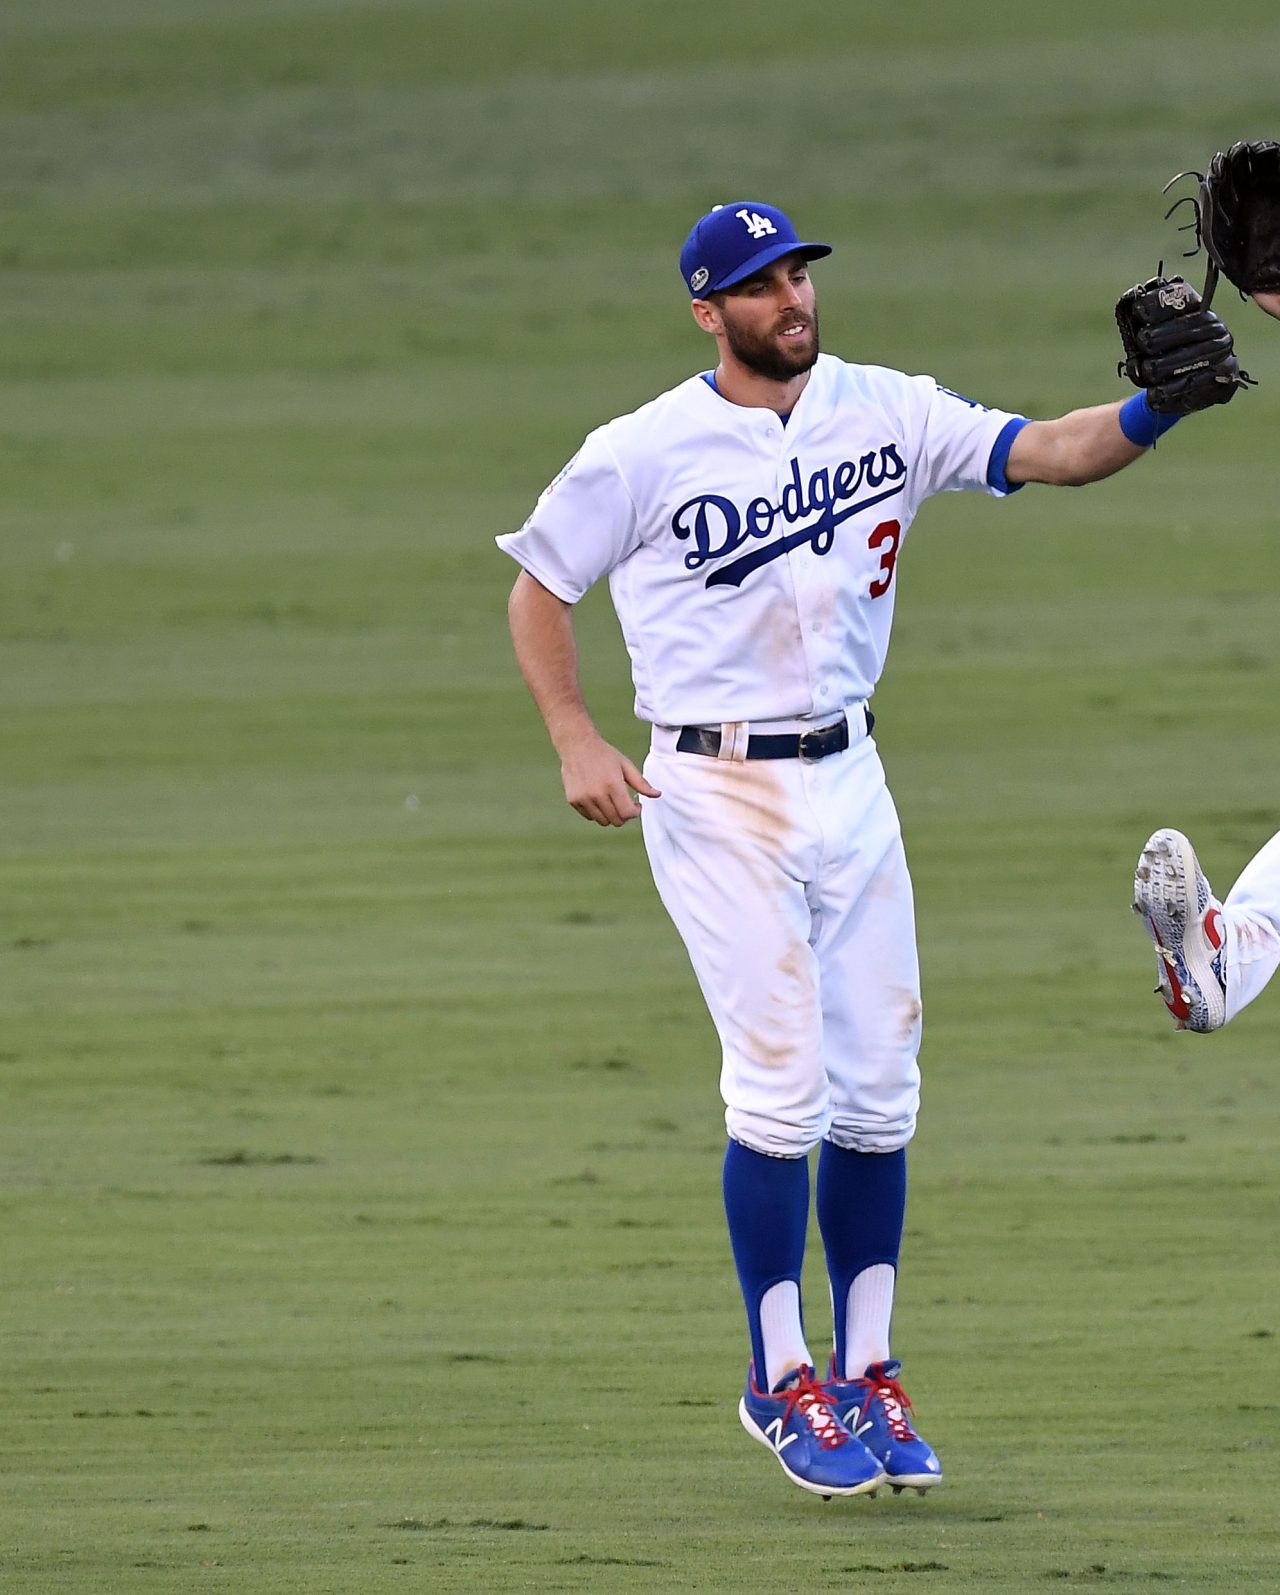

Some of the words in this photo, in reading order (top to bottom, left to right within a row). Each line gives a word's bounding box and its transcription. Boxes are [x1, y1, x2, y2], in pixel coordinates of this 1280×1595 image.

[735, 209, 777, 239] LA
[671, 443, 908, 571] Dodgers
[867, 518, 901, 600] 3
